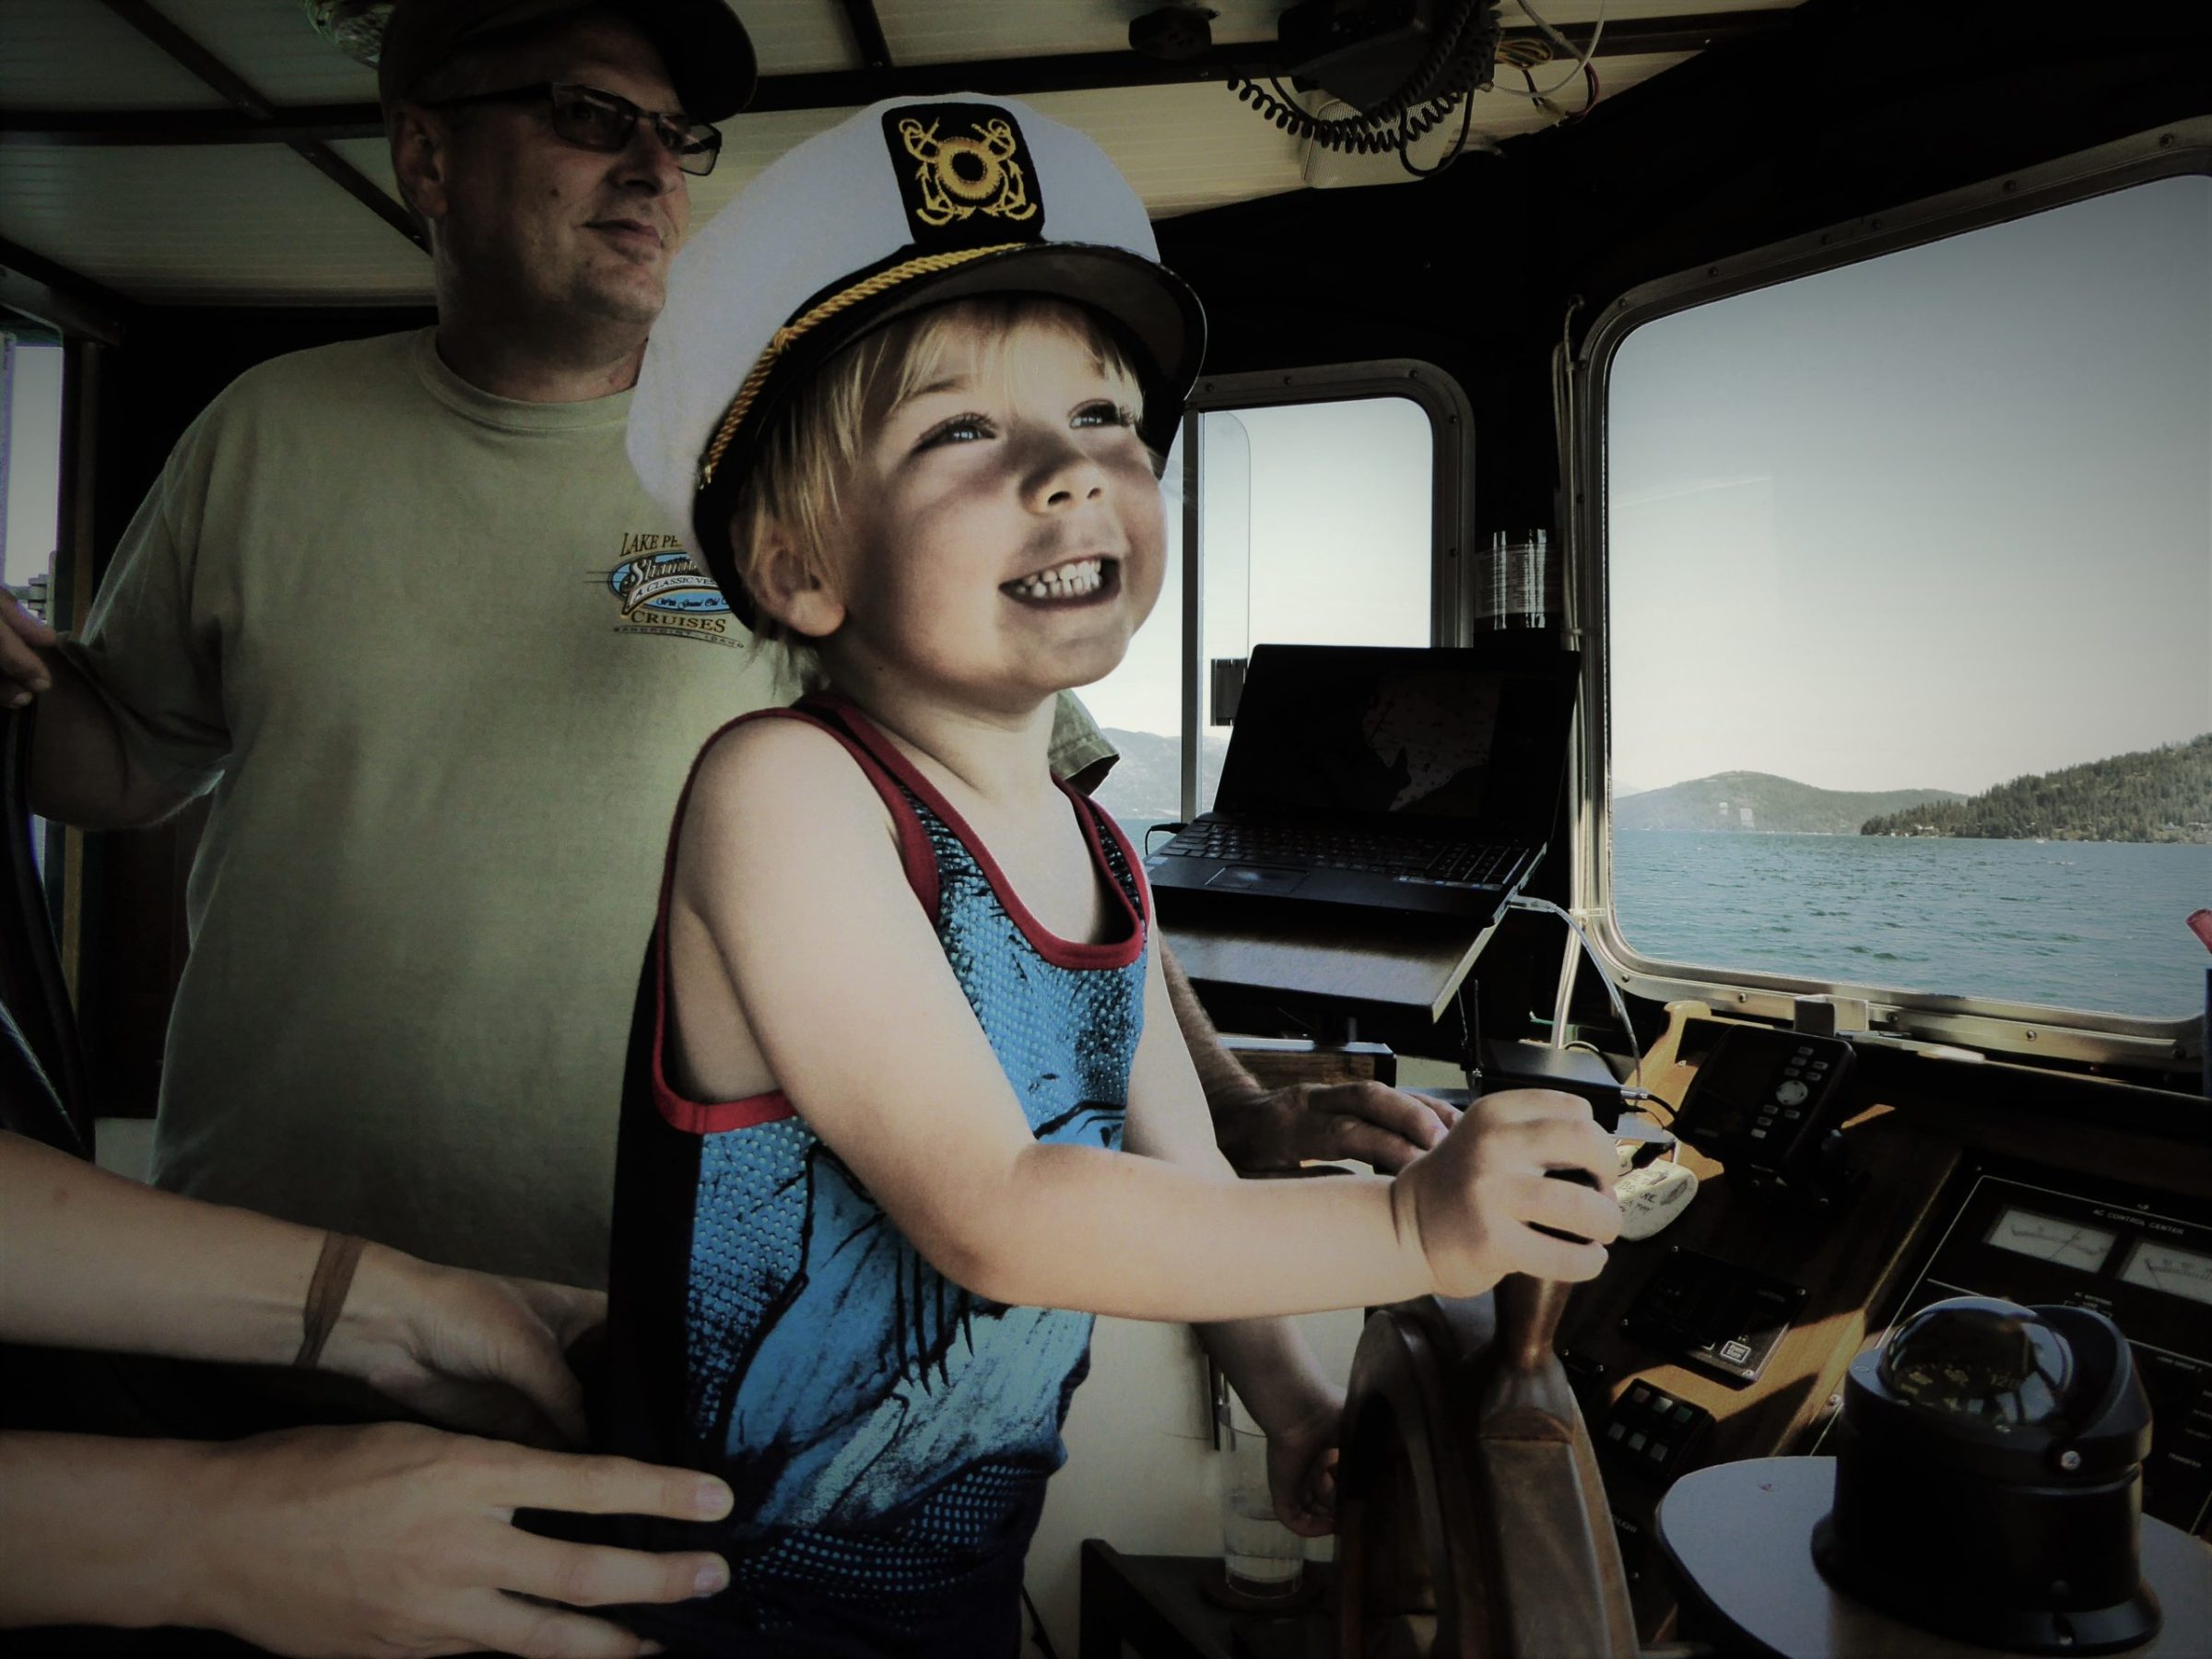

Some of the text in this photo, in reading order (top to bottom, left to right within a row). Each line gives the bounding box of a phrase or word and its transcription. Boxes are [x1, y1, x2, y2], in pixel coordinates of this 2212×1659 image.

[619, 533, 659, 557] LAKE
[646, 576, 694, 593] CLASSIC
[631, 610, 726, 633] CRUISES
